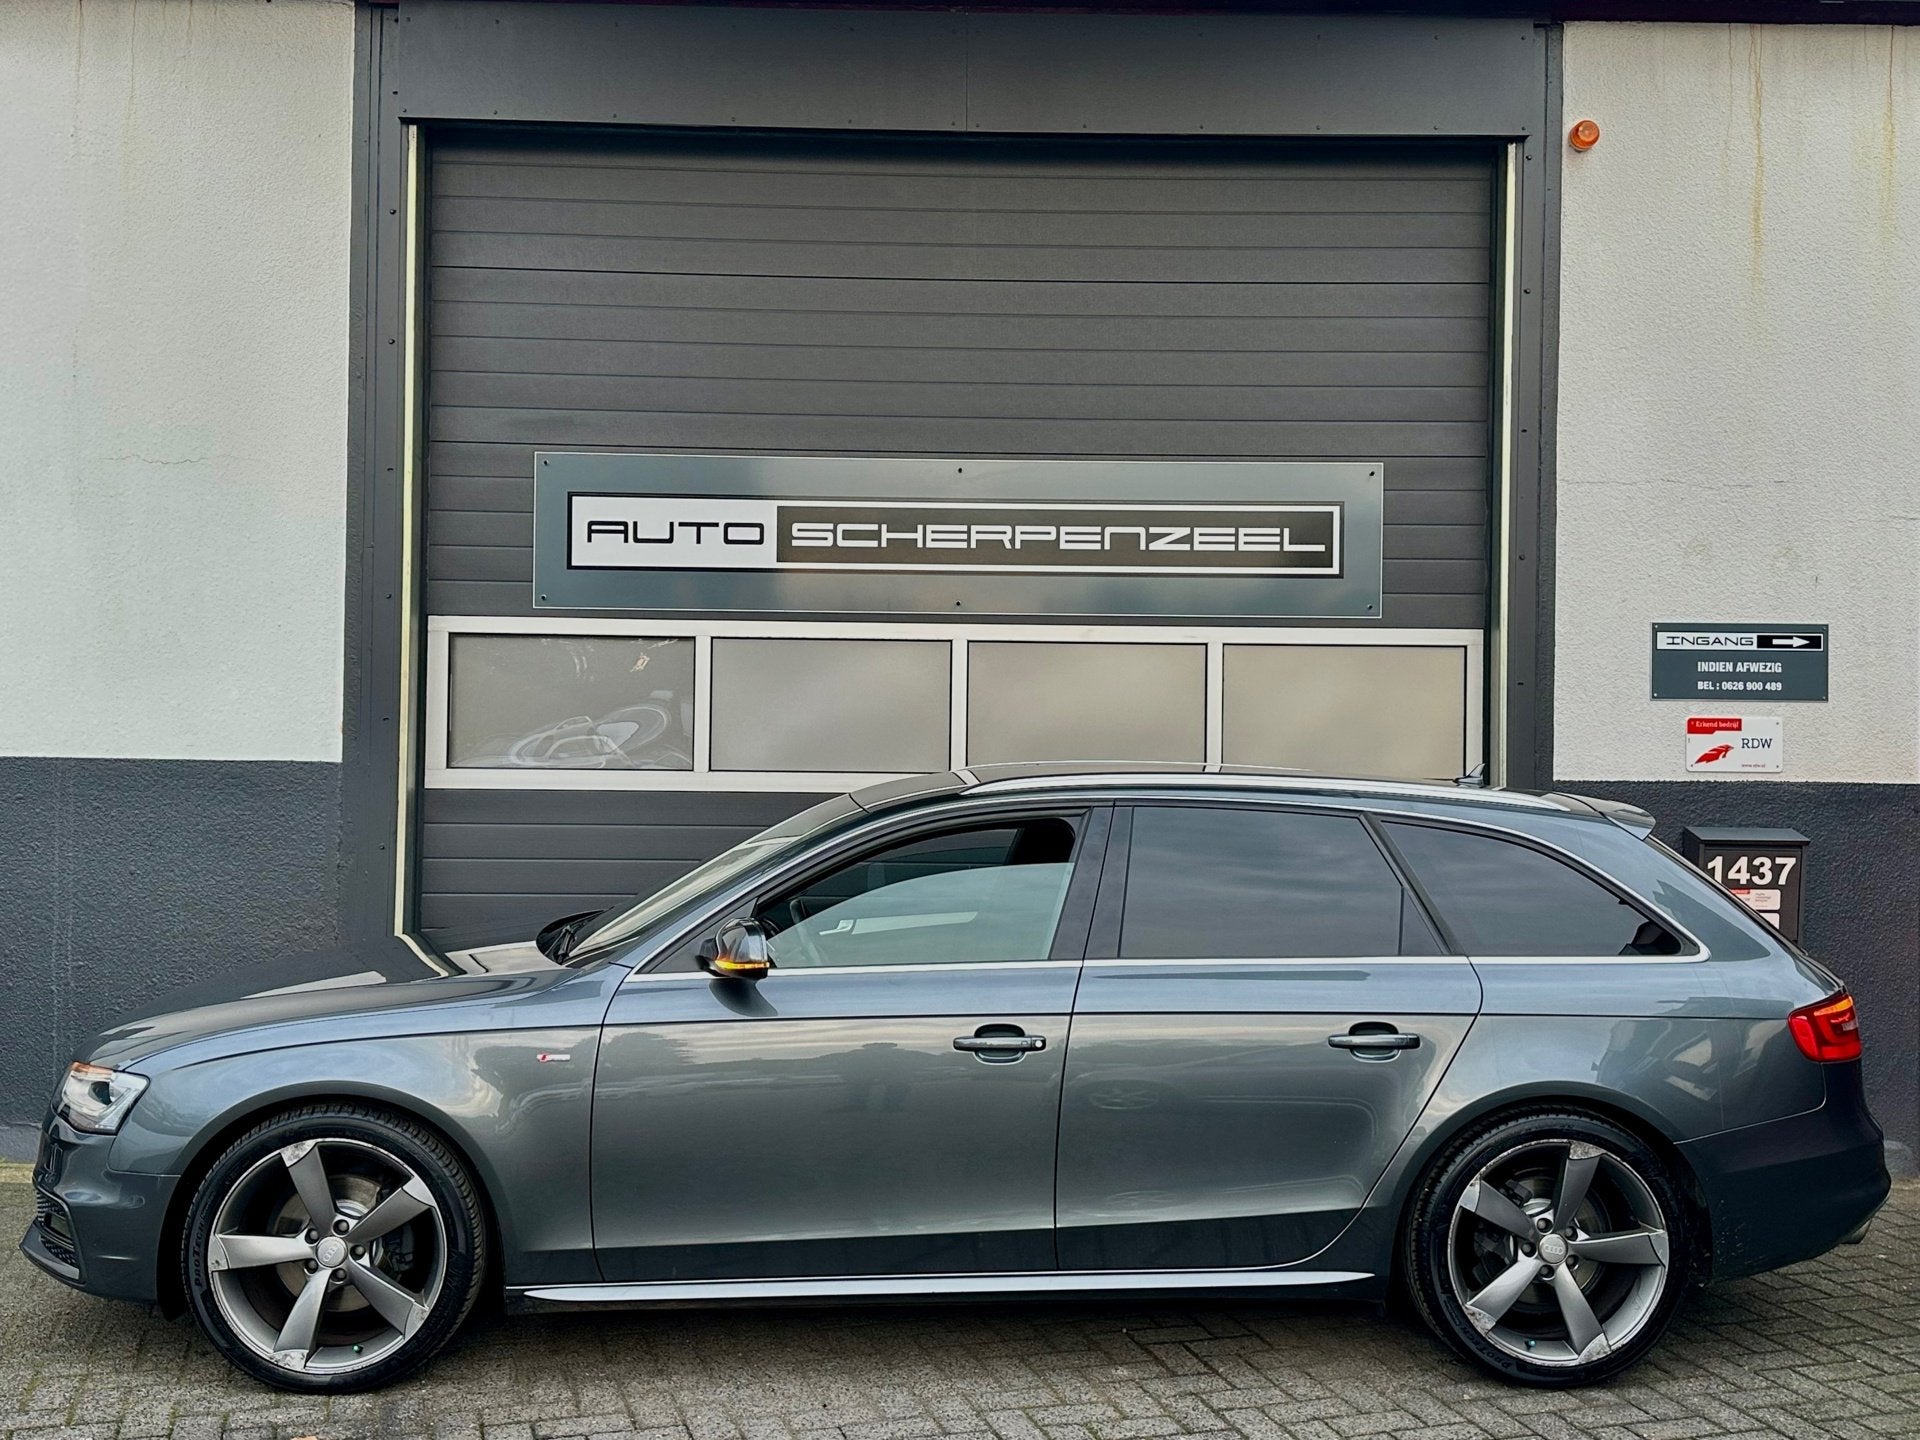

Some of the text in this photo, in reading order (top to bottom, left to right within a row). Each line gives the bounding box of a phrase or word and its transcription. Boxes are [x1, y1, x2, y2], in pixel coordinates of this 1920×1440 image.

[586, 520, 1326, 552] AUTO SCHERPENZEEL
[1666, 636, 1754, 646] INGANG
[1697, 661, 1782, 673] INDIEN AFWEZIG
[1697, 681, 1714, 690] BEL
[1721, 681, 1745, 690] 0626
[1746, 682, 1763, 691] 900
[1764, 682, 1782, 691] 489
[1741, 738, 1773, 749] RDW
[1707, 856, 1797, 886] 1437
